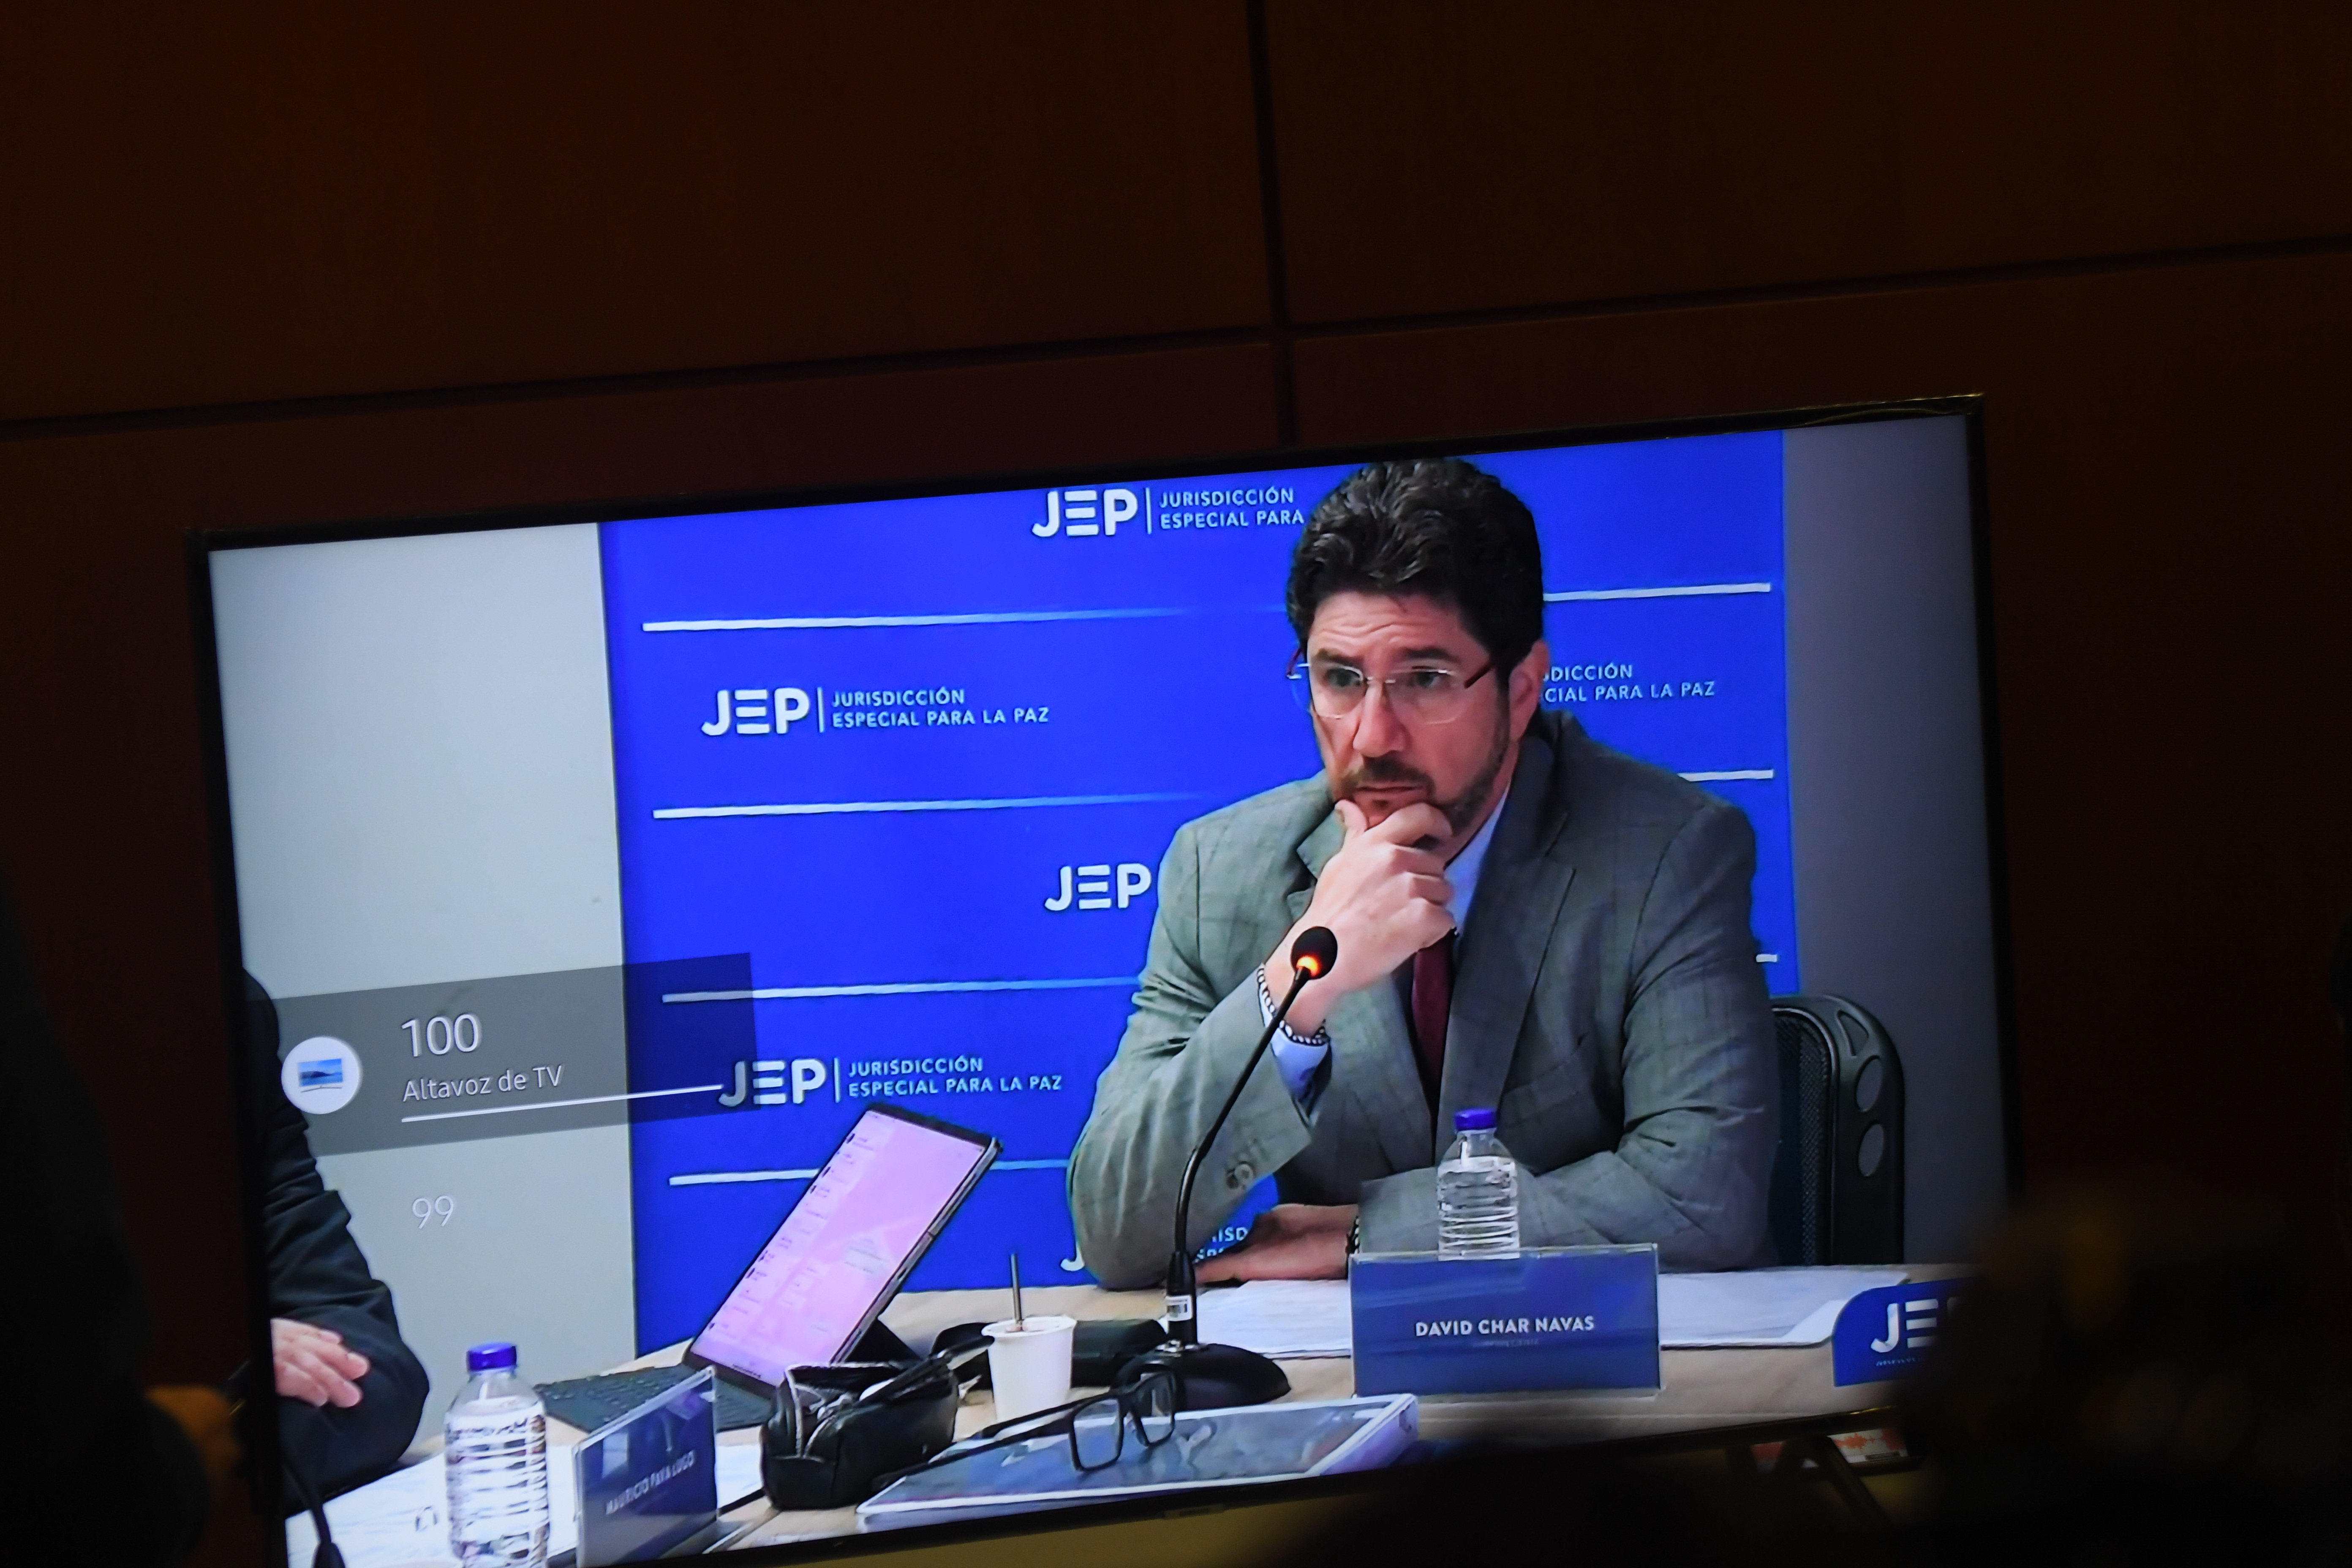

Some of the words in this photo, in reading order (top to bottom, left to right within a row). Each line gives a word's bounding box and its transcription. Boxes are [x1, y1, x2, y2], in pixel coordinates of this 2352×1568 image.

[1160, 486, 1293, 508] JURISDICCIÓN
[1032, 489, 1138, 537] JEP
[1160, 512, 1248, 529] ESPECIAL
[1257, 509, 1304, 525] PARA
[1544, 663, 1632, 682] DICCIÓN
[832, 686, 964, 707] JURISDICCIÓN
[1544, 687, 1587, 703] CIAL
[1595, 685, 1642, 700] PARA
[1651, 683, 1672, 698] LA
[1682, 681, 1715, 697] PAZ
[701, 688, 810, 735] JEP
[833, 711, 919, 727] ESPECIAL
[927, 710, 975, 725] PARA
[983, 709, 1005, 724] LA
[1015, 707, 1049, 722] PAZ
[1044, 863, 1152, 911] JEP
[401, 1014, 482, 1057] 100
[848, 1055, 983, 1077] JURISDICCIÓN
[402, 1074, 492, 1102] Altavoz
[498, 1070, 526, 1093] de
[533, 1064, 563, 1087] TV
[719, 1059, 826, 1106] JEP
[849, 1080, 938, 1097] ESPECIAL
[947, 1078, 993, 1093] PARA
[1001, 1078, 1022, 1092] LA
[1029, 1075, 1062, 1090] PAZ
[411, 1195, 455, 1229] 99
[1416, 1320, 1472, 1337] DAVID
[1478, 1318, 1529, 1334] CHAR
[1535, 1316, 1595, 1332] NAVAS
[1870, 1296, 1964, 1353] JE
